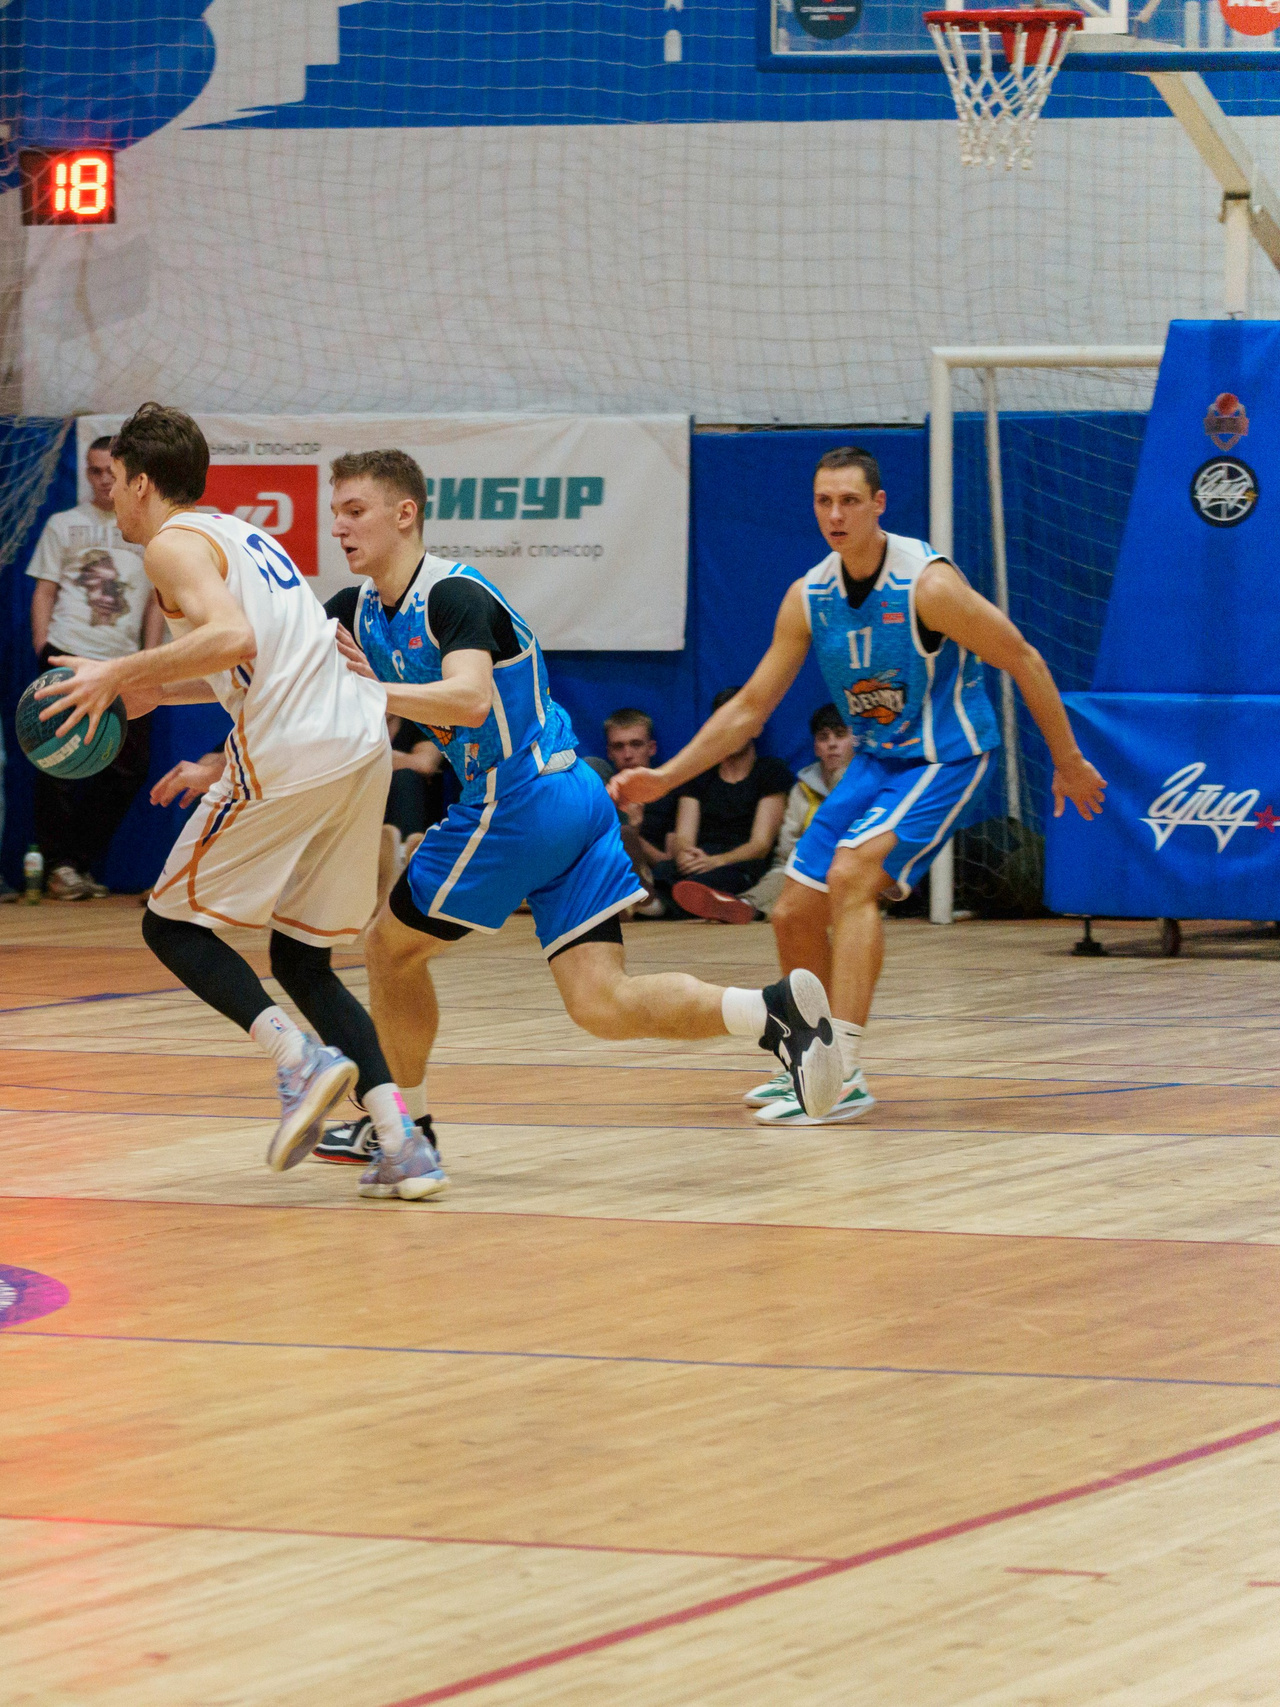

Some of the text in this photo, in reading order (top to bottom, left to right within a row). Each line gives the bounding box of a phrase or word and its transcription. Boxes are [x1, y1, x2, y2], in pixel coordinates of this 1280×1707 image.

[54, 158, 107, 215] 18
[429, 541, 604, 560] еральный спонсор
[846, 626, 873, 669] 17
